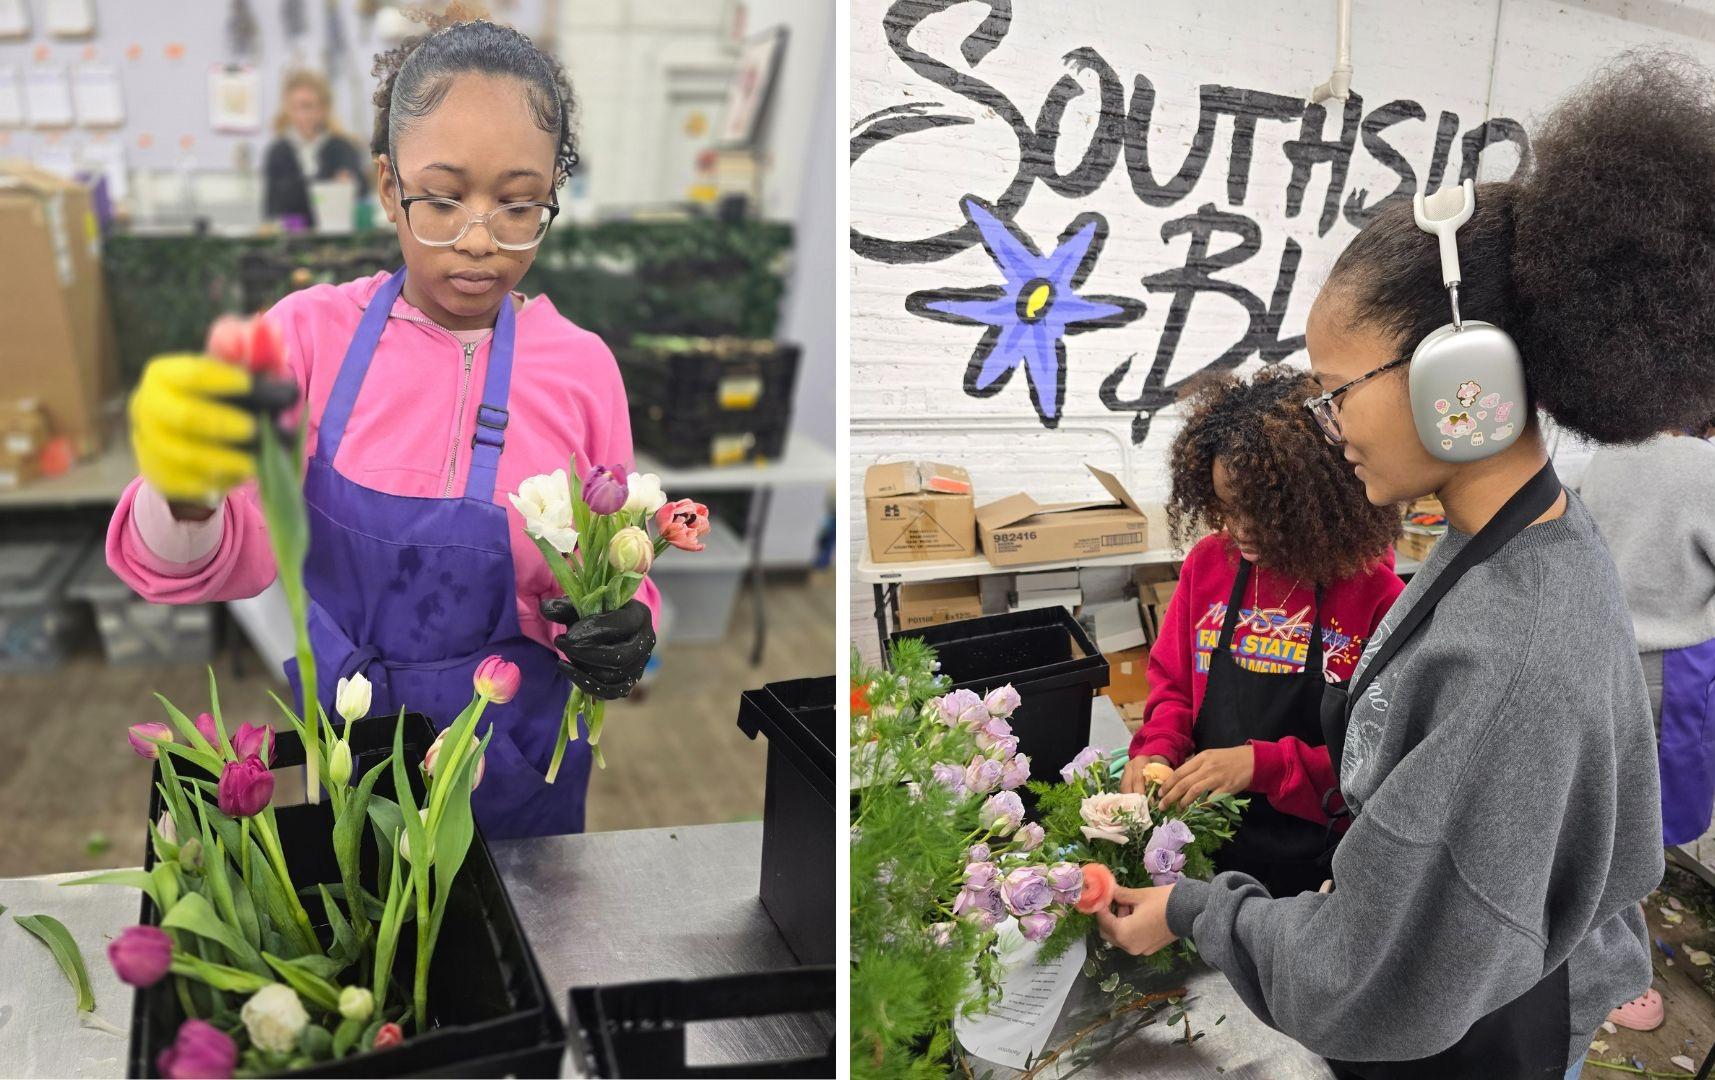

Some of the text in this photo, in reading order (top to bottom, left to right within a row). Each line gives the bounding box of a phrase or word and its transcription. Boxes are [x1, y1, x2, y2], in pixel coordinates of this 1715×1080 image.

[851, 0, 1530, 264] SOUTHSID
[1099, 203, 1307, 445] BL
[993, 531, 1037, 543] 982416
[1198, 629, 1309, 662] FA STATE
[1198, 651, 1293, 674] TOAMENT
